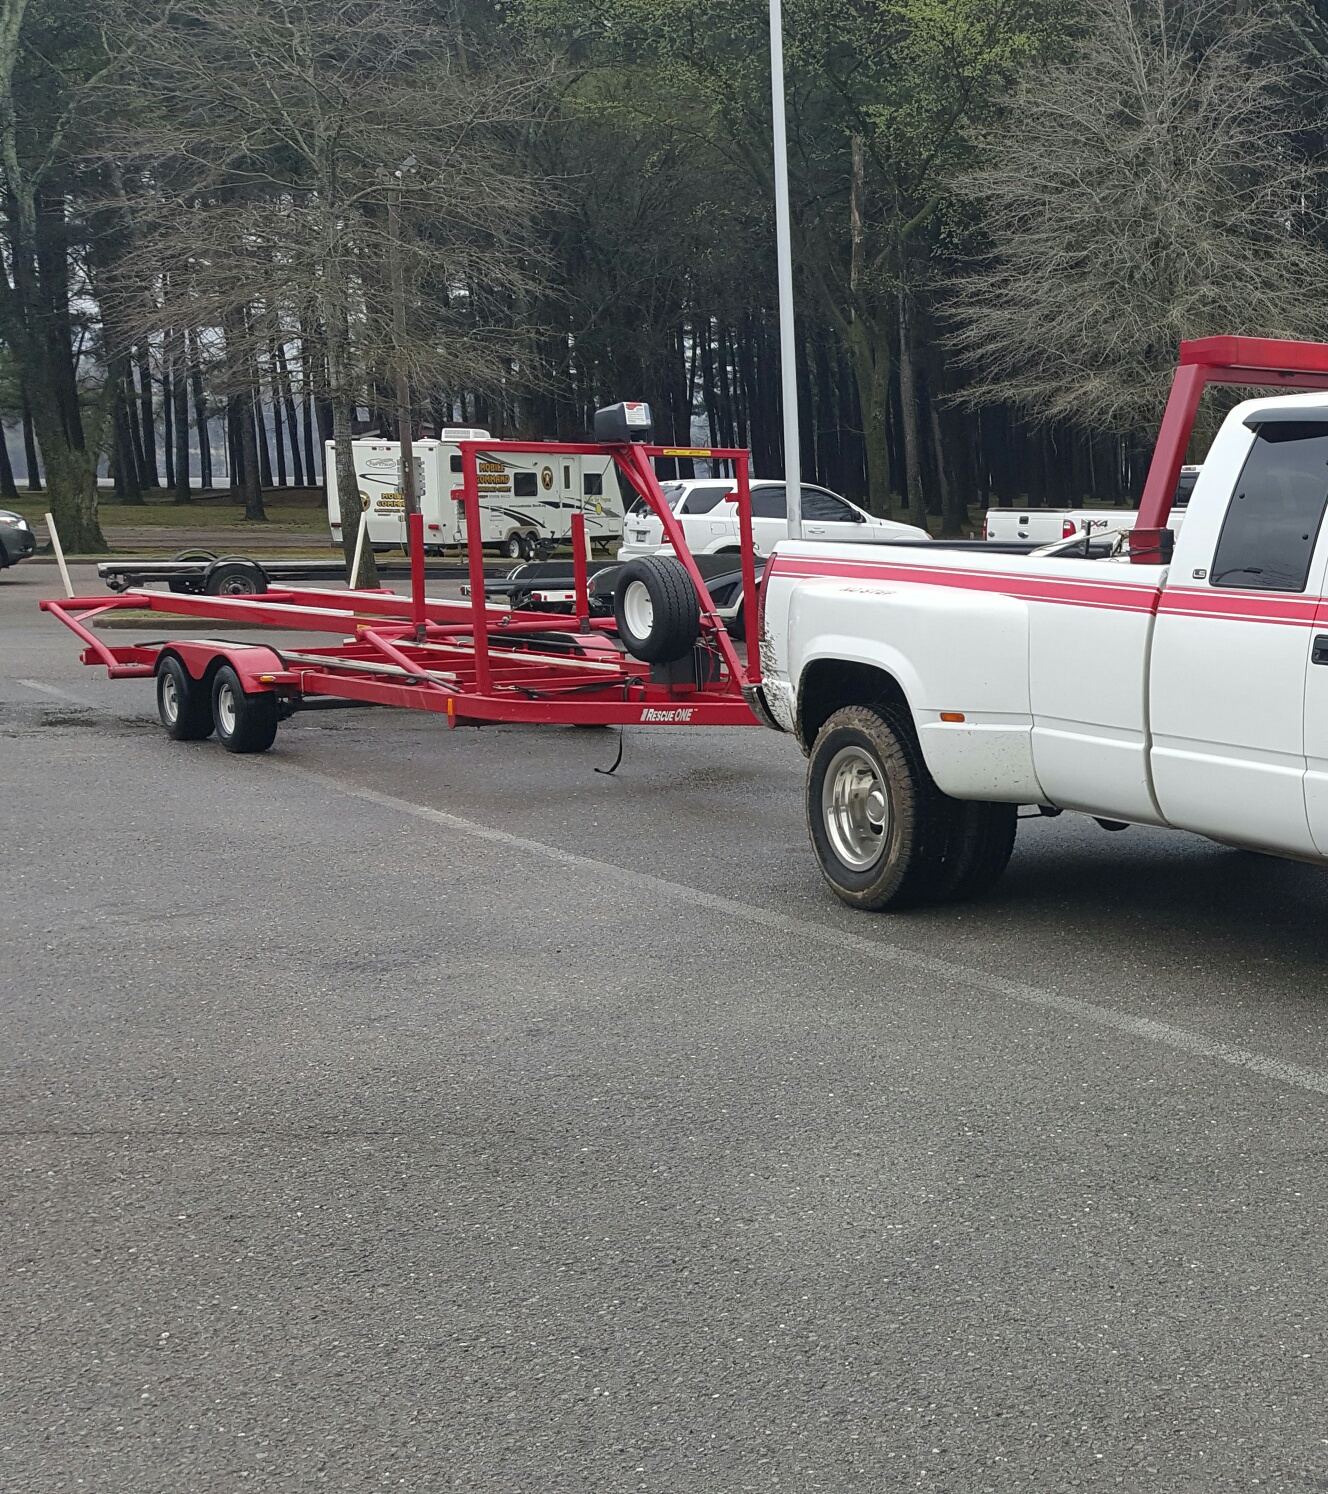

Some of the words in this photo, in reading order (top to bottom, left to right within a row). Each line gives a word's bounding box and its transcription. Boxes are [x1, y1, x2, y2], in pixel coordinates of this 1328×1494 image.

[479, 463, 506, 473] MOBILE
[1193, 570, 1206, 578] LS
[646, 708, 675, 721] RESCUE
[674, 708, 693, 721] ONE
